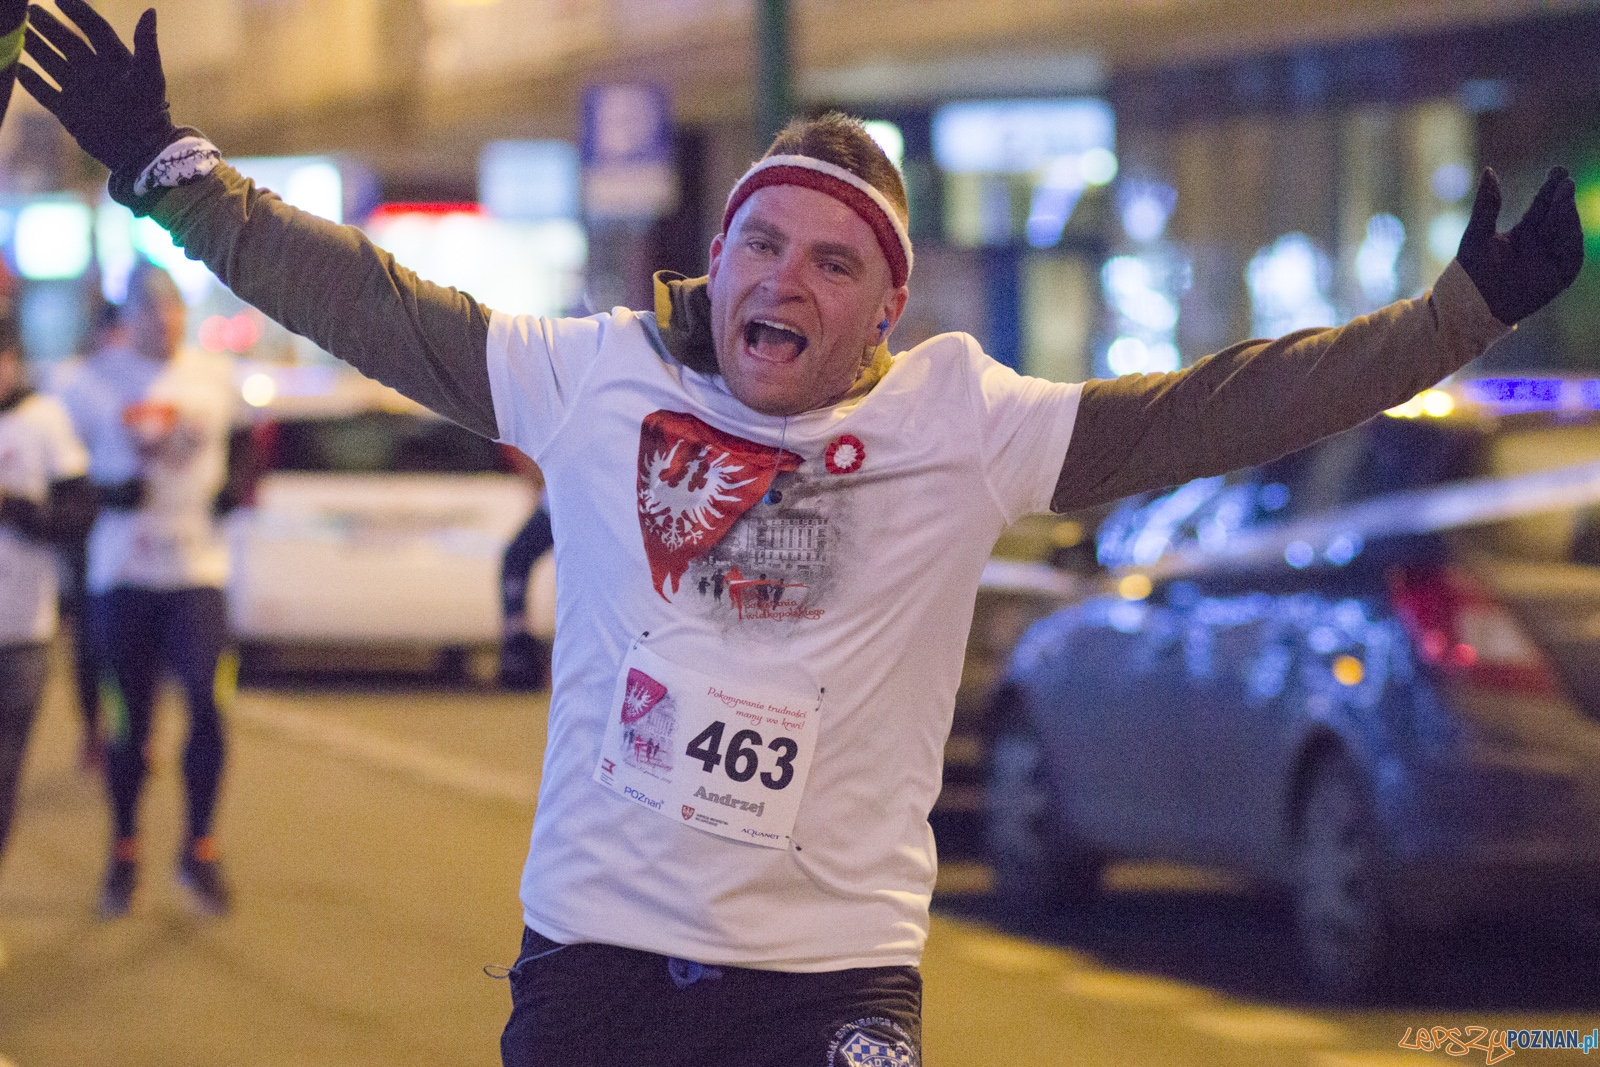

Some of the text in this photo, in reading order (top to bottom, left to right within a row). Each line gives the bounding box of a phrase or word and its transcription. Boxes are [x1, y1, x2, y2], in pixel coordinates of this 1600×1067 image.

[736, 710, 762, 726] mamy
[685, 720, 799, 790] 463
[693, 786, 765, 817] Andrzej
